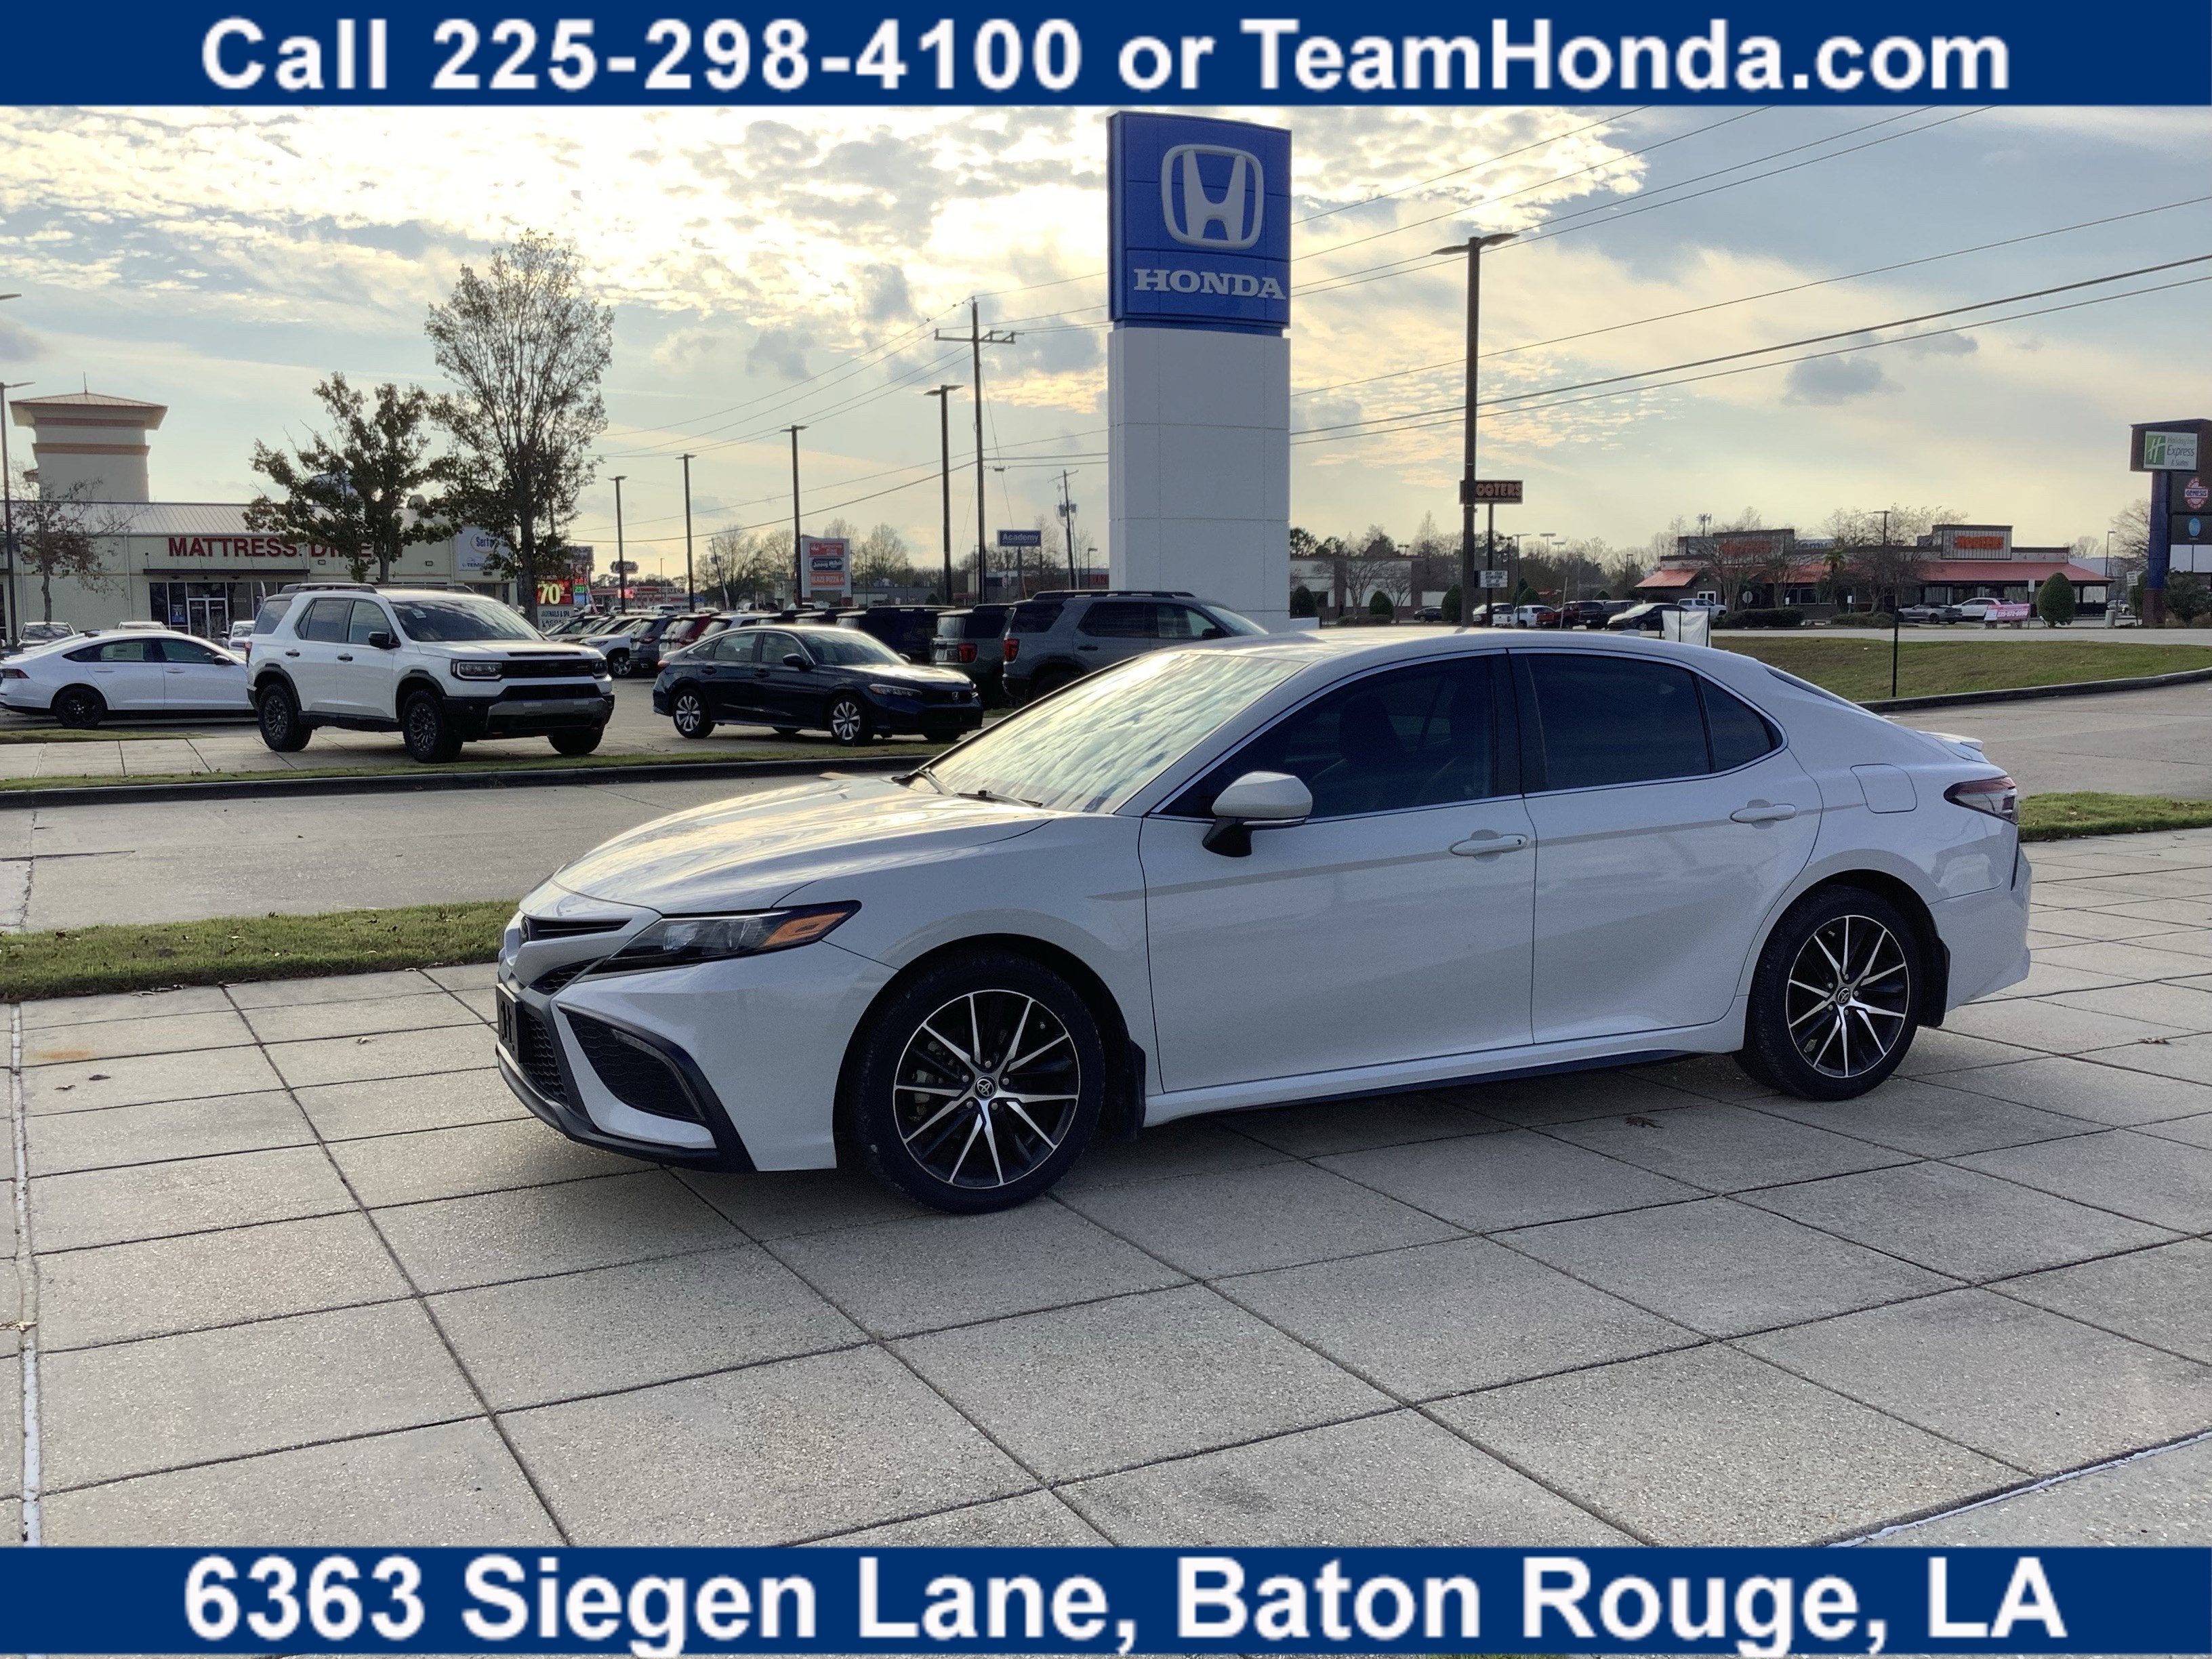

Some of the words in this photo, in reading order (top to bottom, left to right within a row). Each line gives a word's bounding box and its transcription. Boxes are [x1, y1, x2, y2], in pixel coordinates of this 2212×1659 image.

[1133, 268, 1287, 300] HONDA
[2167, 445, 2195, 459] Express
[1476, 483, 1522, 497] OOTERS
[1002, 533, 1039, 542] Academy
[169, 537, 298, 558] MATTRESS
